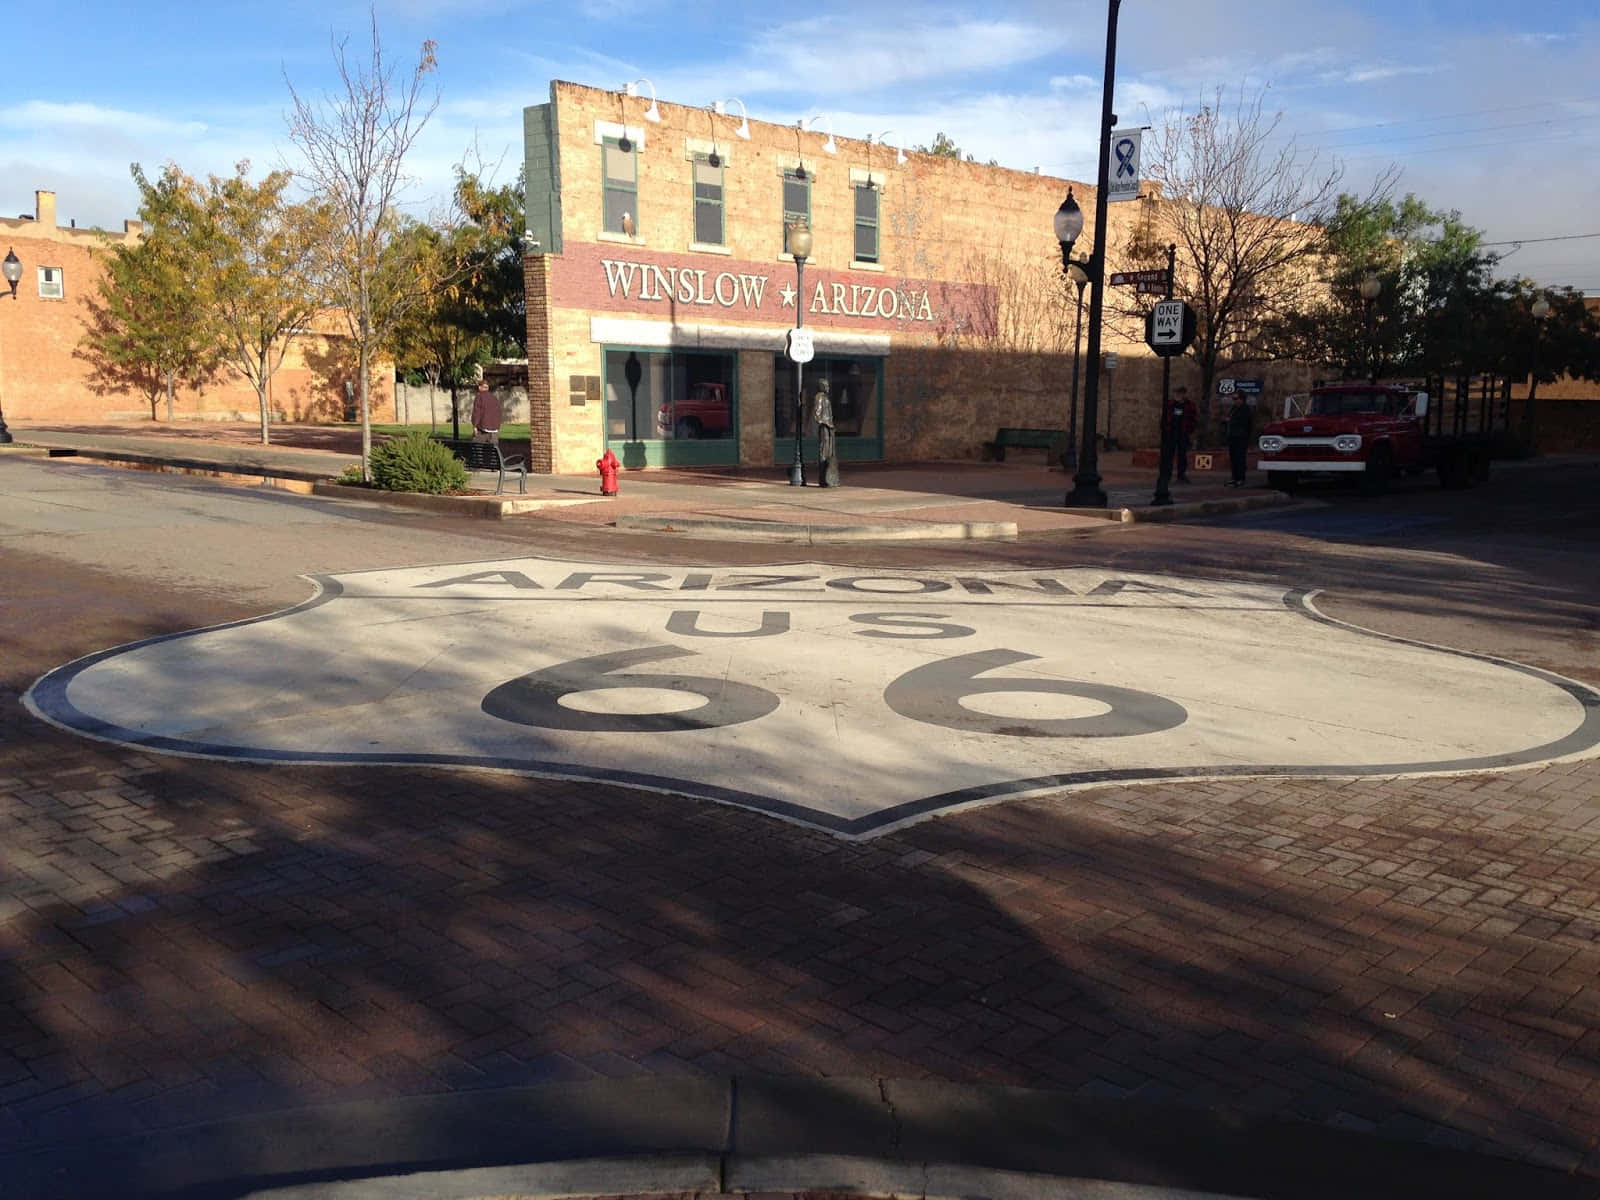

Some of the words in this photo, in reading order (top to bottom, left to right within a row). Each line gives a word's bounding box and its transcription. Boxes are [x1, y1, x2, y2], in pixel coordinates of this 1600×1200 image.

[601, 259, 768, 309] WINSLOW
[810, 281, 933, 322] ARIZONA
[1158, 304, 1180, 316] ONE
[1157, 316, 1180, 328] WAY
[1220, 382, 1234, 394] 66
[410, 570, 1216, 598] ARIZONA
[481, 645, 1189, 738] 66
